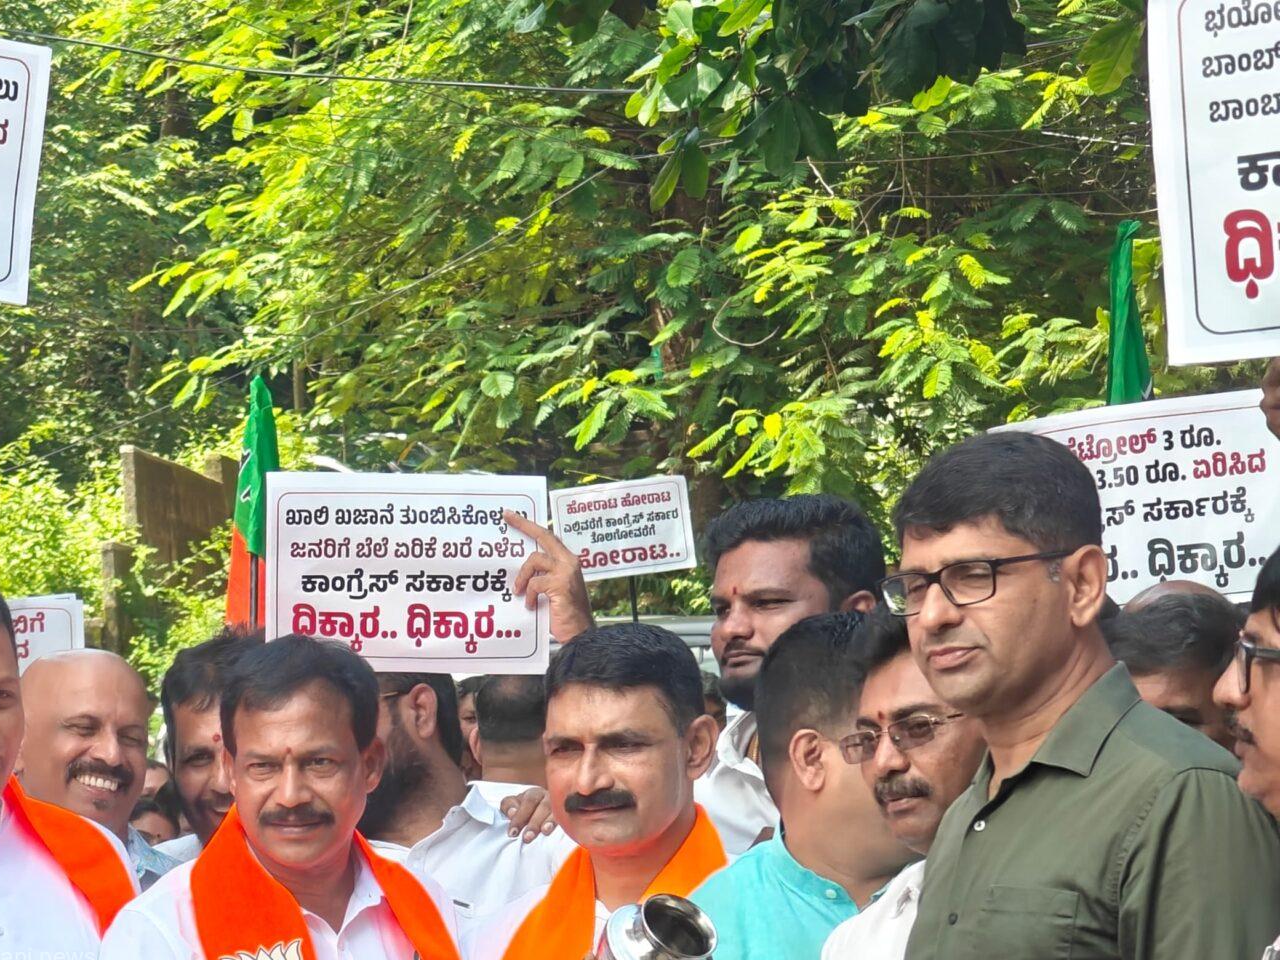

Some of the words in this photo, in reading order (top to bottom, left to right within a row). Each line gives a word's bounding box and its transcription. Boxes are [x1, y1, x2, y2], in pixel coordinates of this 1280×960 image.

[1162, 430, 1175, 451] 3
[1180, 424, 1222, 449] ರೂ.
[1096, 465, 1139, 490] 3.50
[1145, 459, 1187, 484] ರೂ.
[1192, 448, 1267, 480] ಏರಿಸಿದ
[285, 507, 329, 527] ಖಾಲಿ
[335, 503, 395, 526] ಖಜಾನೆ
[566, 500, 618, 515] ಹೋರಾಟ
[621, 491, 672, 508] ಹೋರಾಟ
[1142, 486, 1256, 524] ಸರ್ಕಾರಕ್ಕೆ
[605, 512, 644, 528] ಕಾಂಗ್ರೆಸ್
[646, 508, 679, 522] ಸರ್ಕಾರ
[290, 538, 351, 559] ಜನರಿಗೆ
[356, 538, 389, 559] ಬೆಲೆ
[395, 537, 437, 560] ಏರಿಕೆ
[442, 538, 472, 559] ಬರೆ
[478, 538, 525, 558] ಎಳೆದ
[301, 568, 399, 600] ಕಾಂಗ್ರೆಸ್
[405, 569, 513, 602] ಸರ್ಕಾರಕ್ಕೆ
[406, 603, 522, 653] ಧಿಕ್ಕಾರ...
